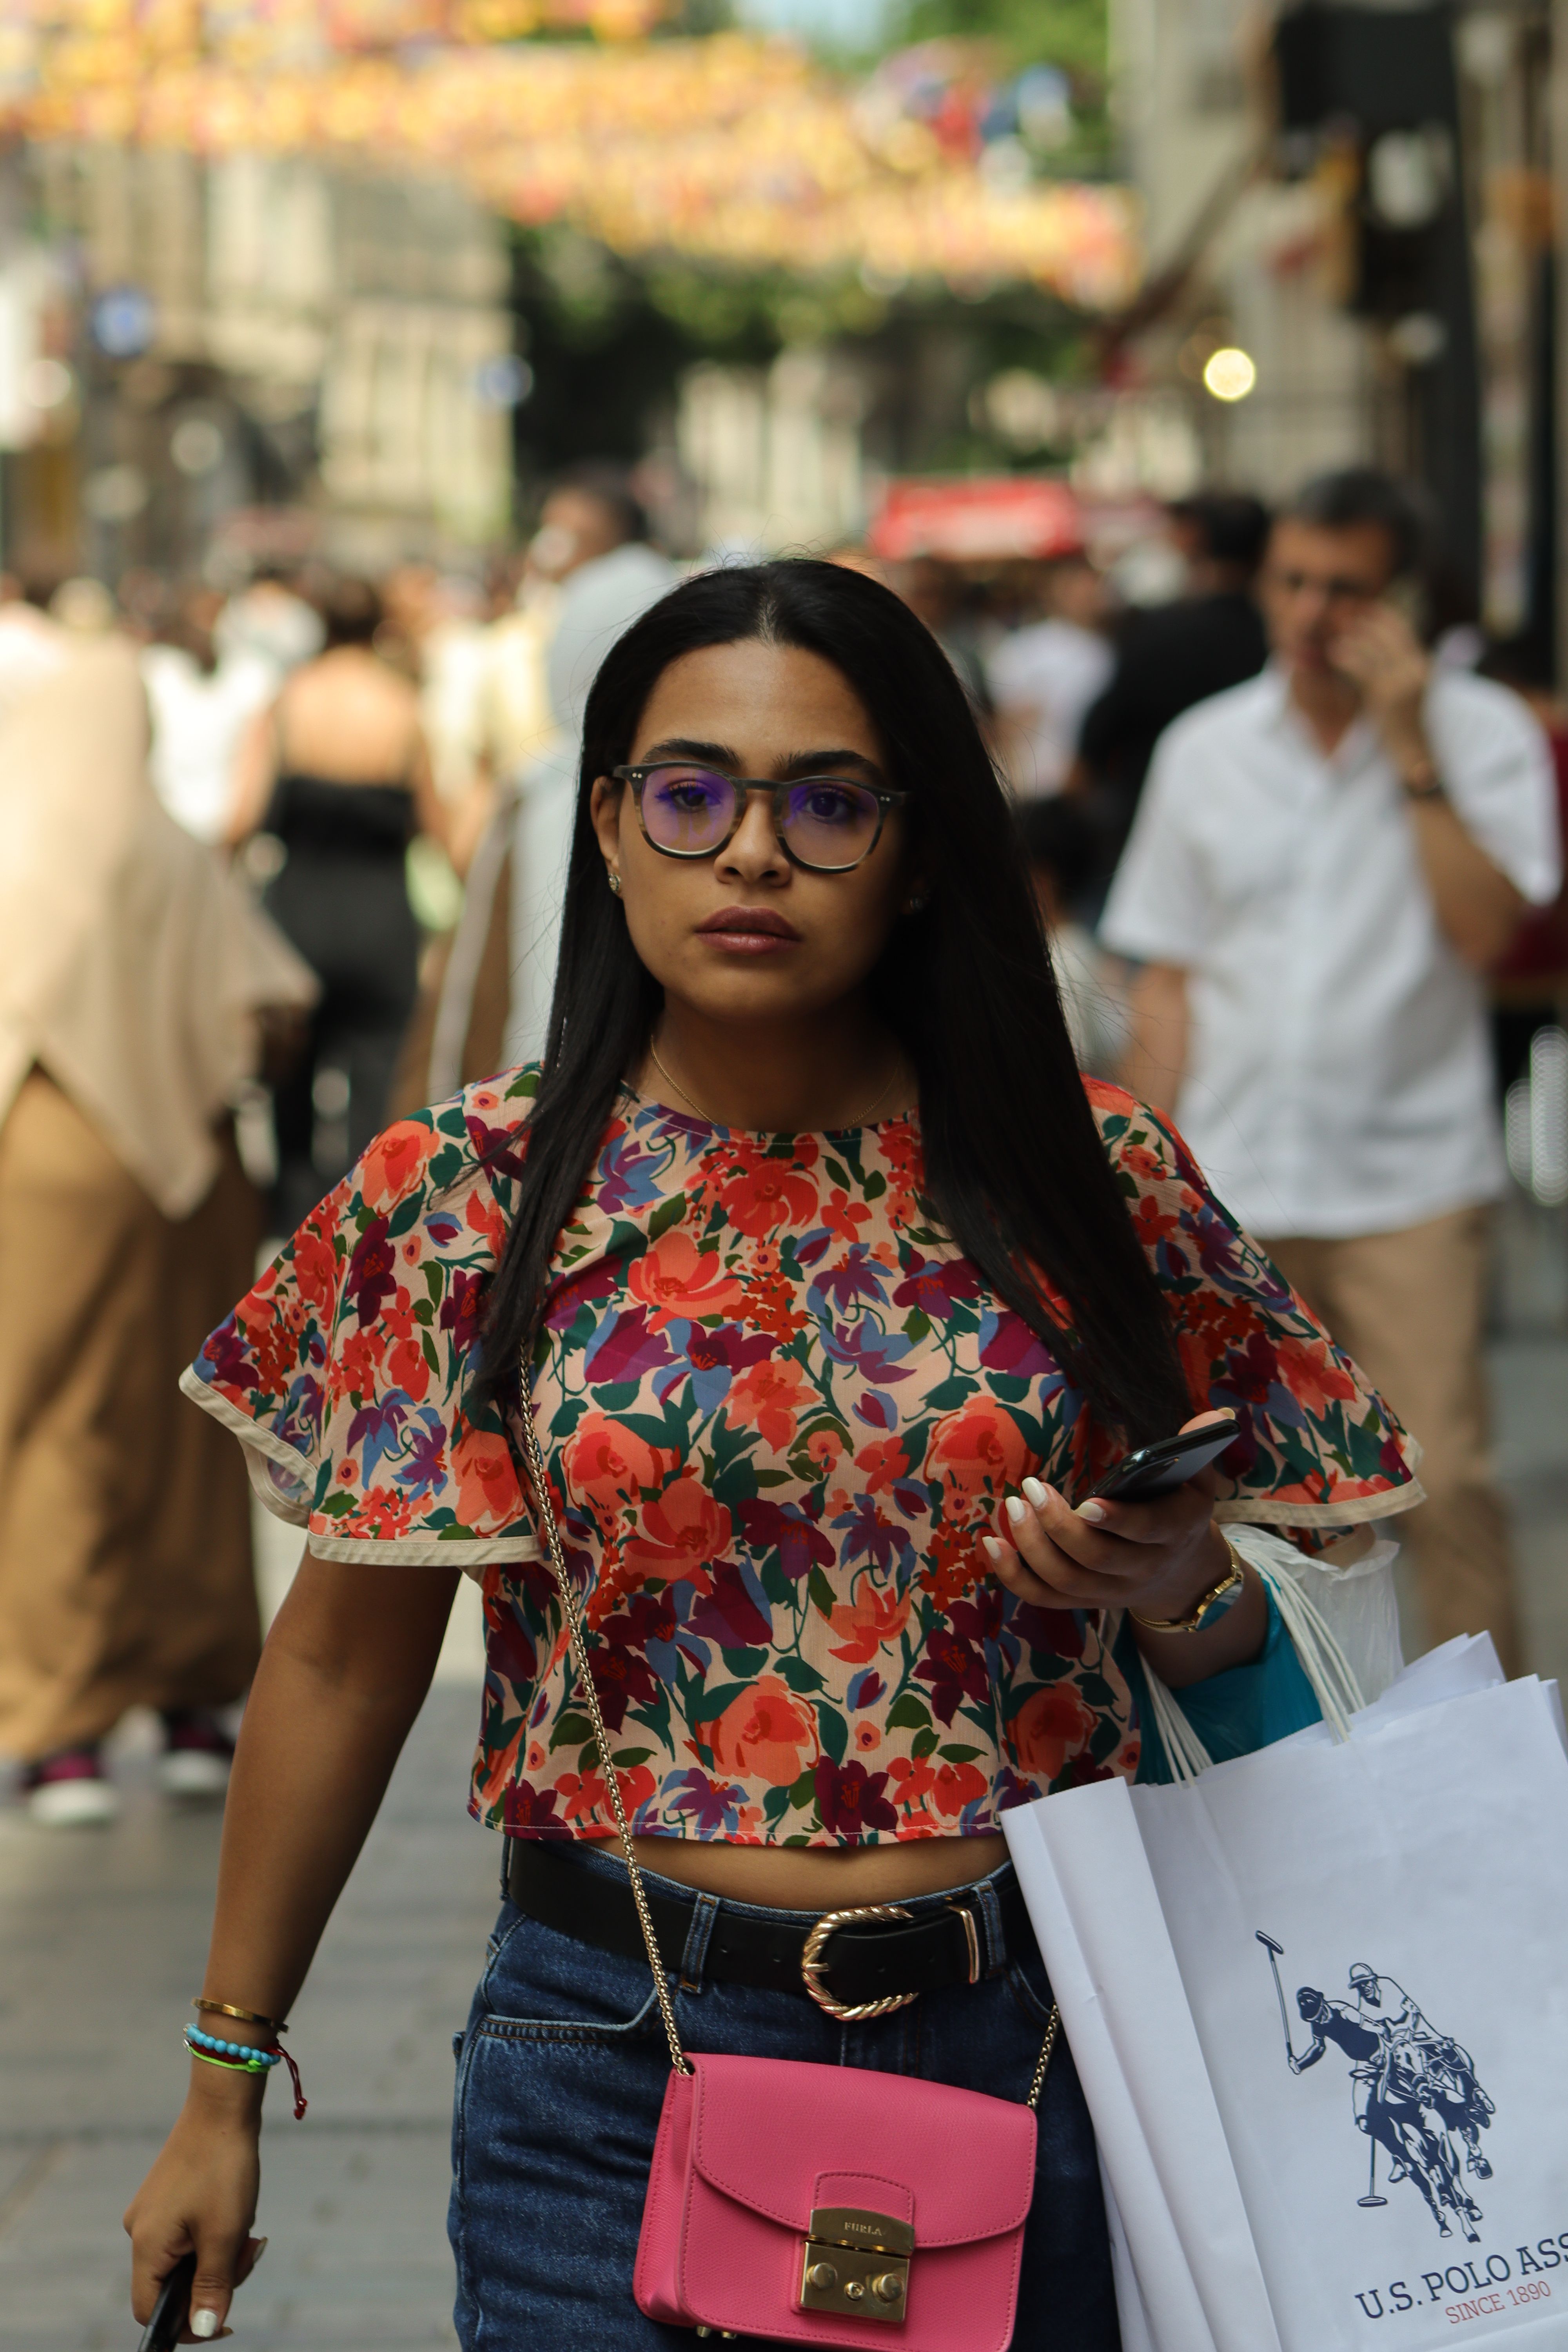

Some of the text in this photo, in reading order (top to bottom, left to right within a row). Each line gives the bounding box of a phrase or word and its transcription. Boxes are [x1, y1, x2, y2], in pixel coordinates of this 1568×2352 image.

[844, 2221, 882, 2236] FURLA
[1354, 2282, 1423, 2319] U.S.
[1421, 2254, 1511, 2301] POLO
[1445, 2281, 1551, 2323] SINCE 1890
